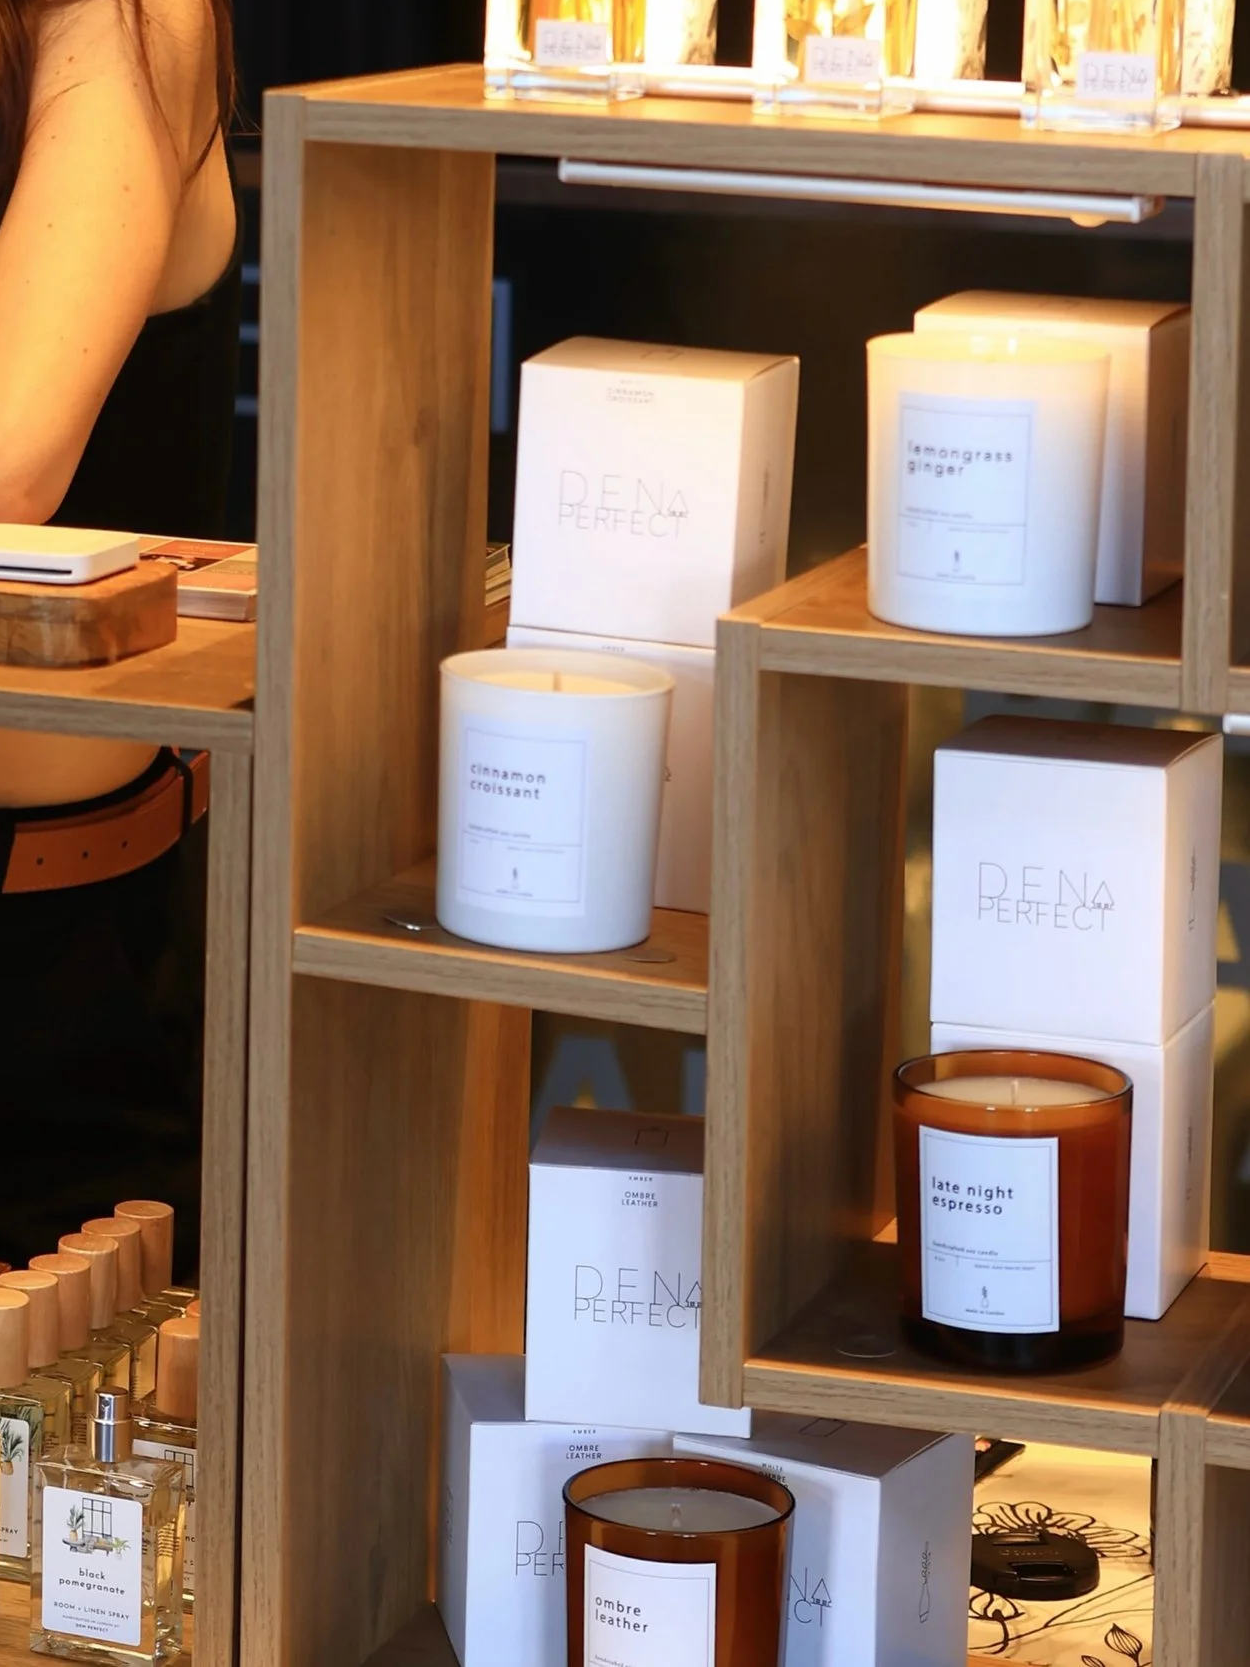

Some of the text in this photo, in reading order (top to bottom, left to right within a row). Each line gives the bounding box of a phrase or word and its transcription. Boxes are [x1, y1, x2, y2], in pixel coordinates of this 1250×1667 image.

[907, 439, 1013, 465] lemongrass
[907, 459, 965, 478] ginger
[558, 504, 688, 538] PERFECT
[470, 763, 547, 784] cinnamon
[470, 779, 541, 800] croissant
[978, 896, 1114, 932] PERFECT
[625, 1191, 655, 1200] OMBRE
[932, 1176, 1015, 1201] late night
[622, 1199, 658, 1207] LEATHER
[932, 1194, 1003, 1216] espresso
[574, 1297, 703, 1329] PERFECT
[566, 1452, 602, 1460] LEATHER
[79, 1567, 105, 1580] black
[59, 1578, 125, 1594] pomegranate
[54, 1601, 75, 1609] ROOM
[84, 1607, 106, 1615] LINEN
[108, 1611, 129, 1619] SPRAY
[595, 1596, 641, 1617] ombre
[595, 1609, 649, 1633] leather
